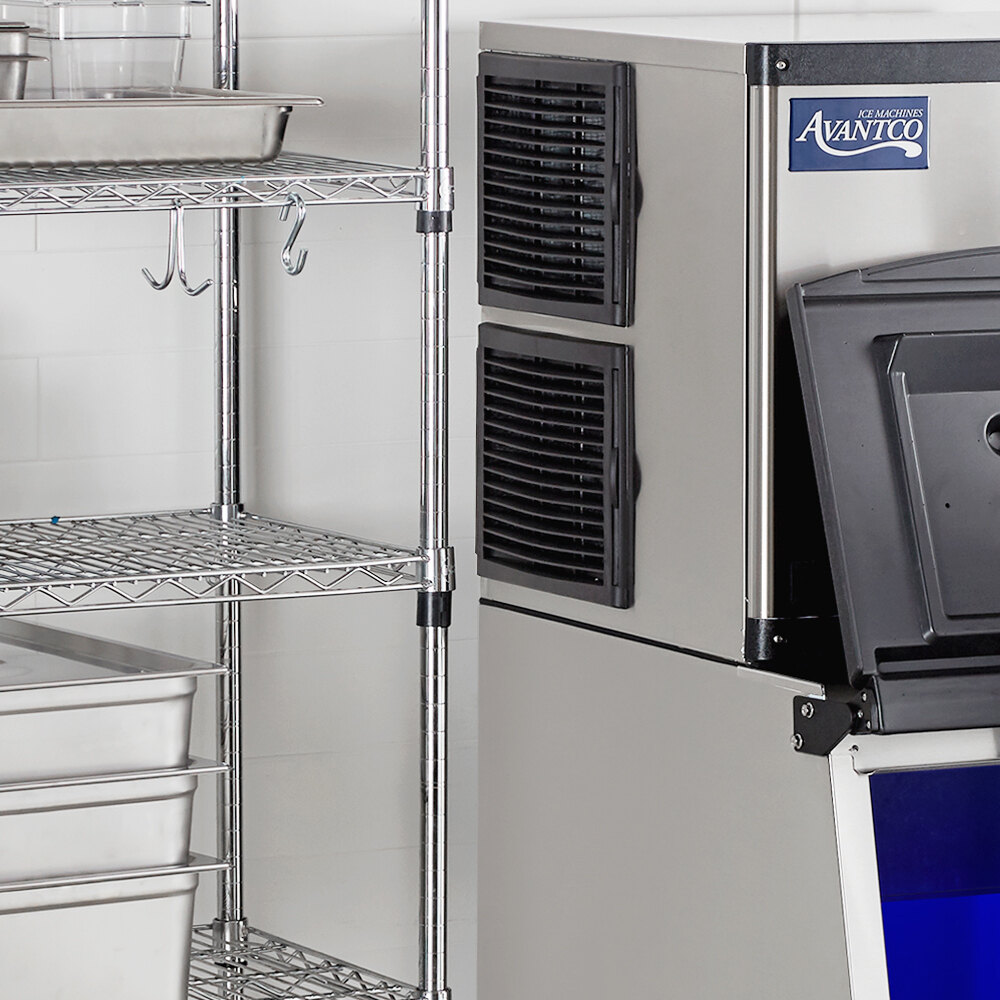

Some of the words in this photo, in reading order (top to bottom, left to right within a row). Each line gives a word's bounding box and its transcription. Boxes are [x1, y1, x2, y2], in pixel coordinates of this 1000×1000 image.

[858, 109, 874, 119] ICE
[875, 108, 924, 118] MACHINES
[795, 110, 924, 158] AVANTCO
